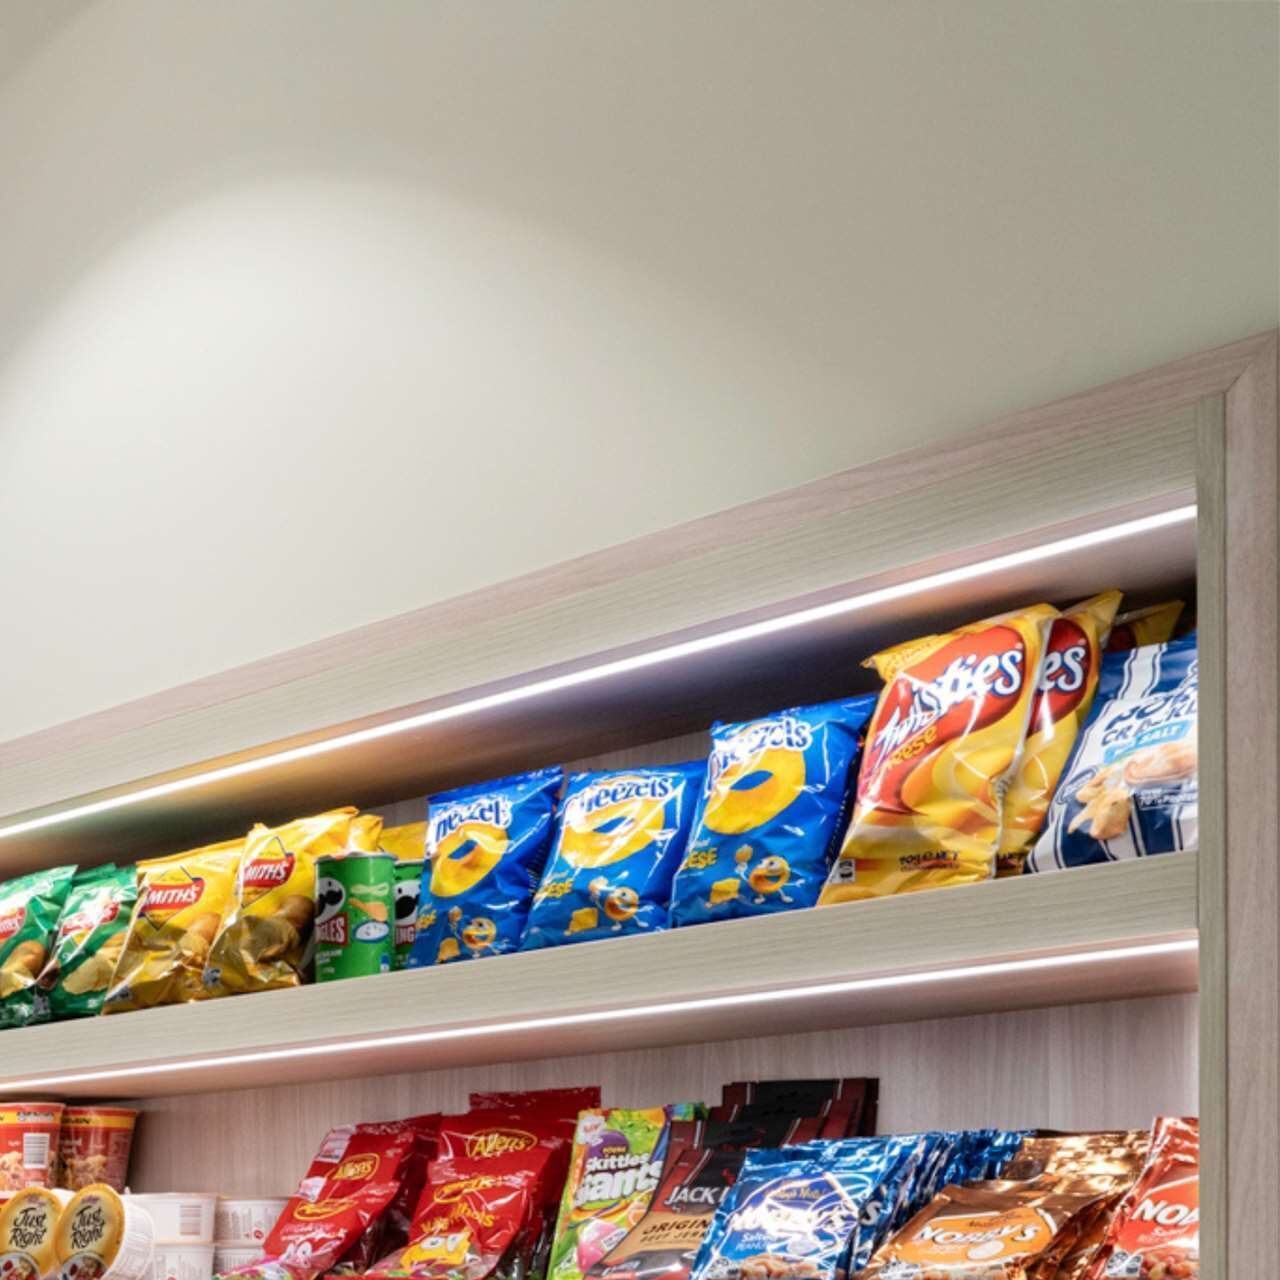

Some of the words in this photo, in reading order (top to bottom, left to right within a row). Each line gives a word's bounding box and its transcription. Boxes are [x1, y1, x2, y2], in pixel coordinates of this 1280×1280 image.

[587, 1153, 651, 1171] skittles
[665, 1186, 717, 1205] JACK
[13, 1206, 48, 1229] Just
[72, 1205, 106, 1231] Just
[9, 1226, 48, 1249] Right
[71, 1224, 106, 1250] Right
